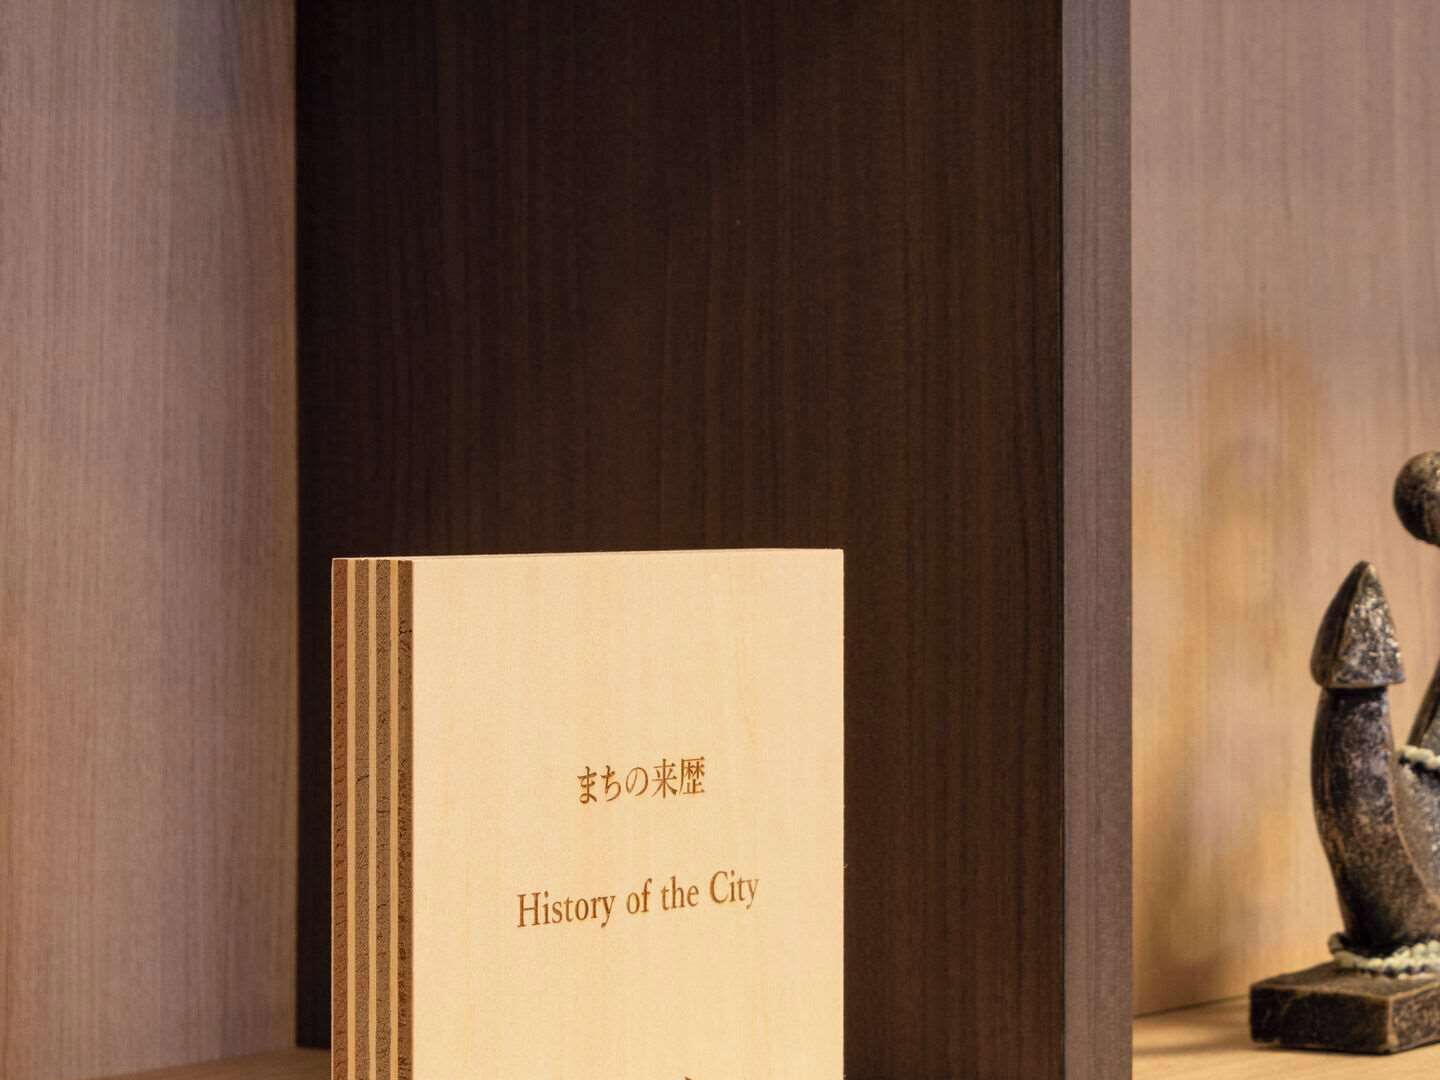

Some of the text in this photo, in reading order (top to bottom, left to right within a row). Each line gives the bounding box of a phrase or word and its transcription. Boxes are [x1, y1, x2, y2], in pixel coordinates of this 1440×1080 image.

[577, 756, 706, 805] まちの来歴
[517, 869, 760, 929] History of the City
